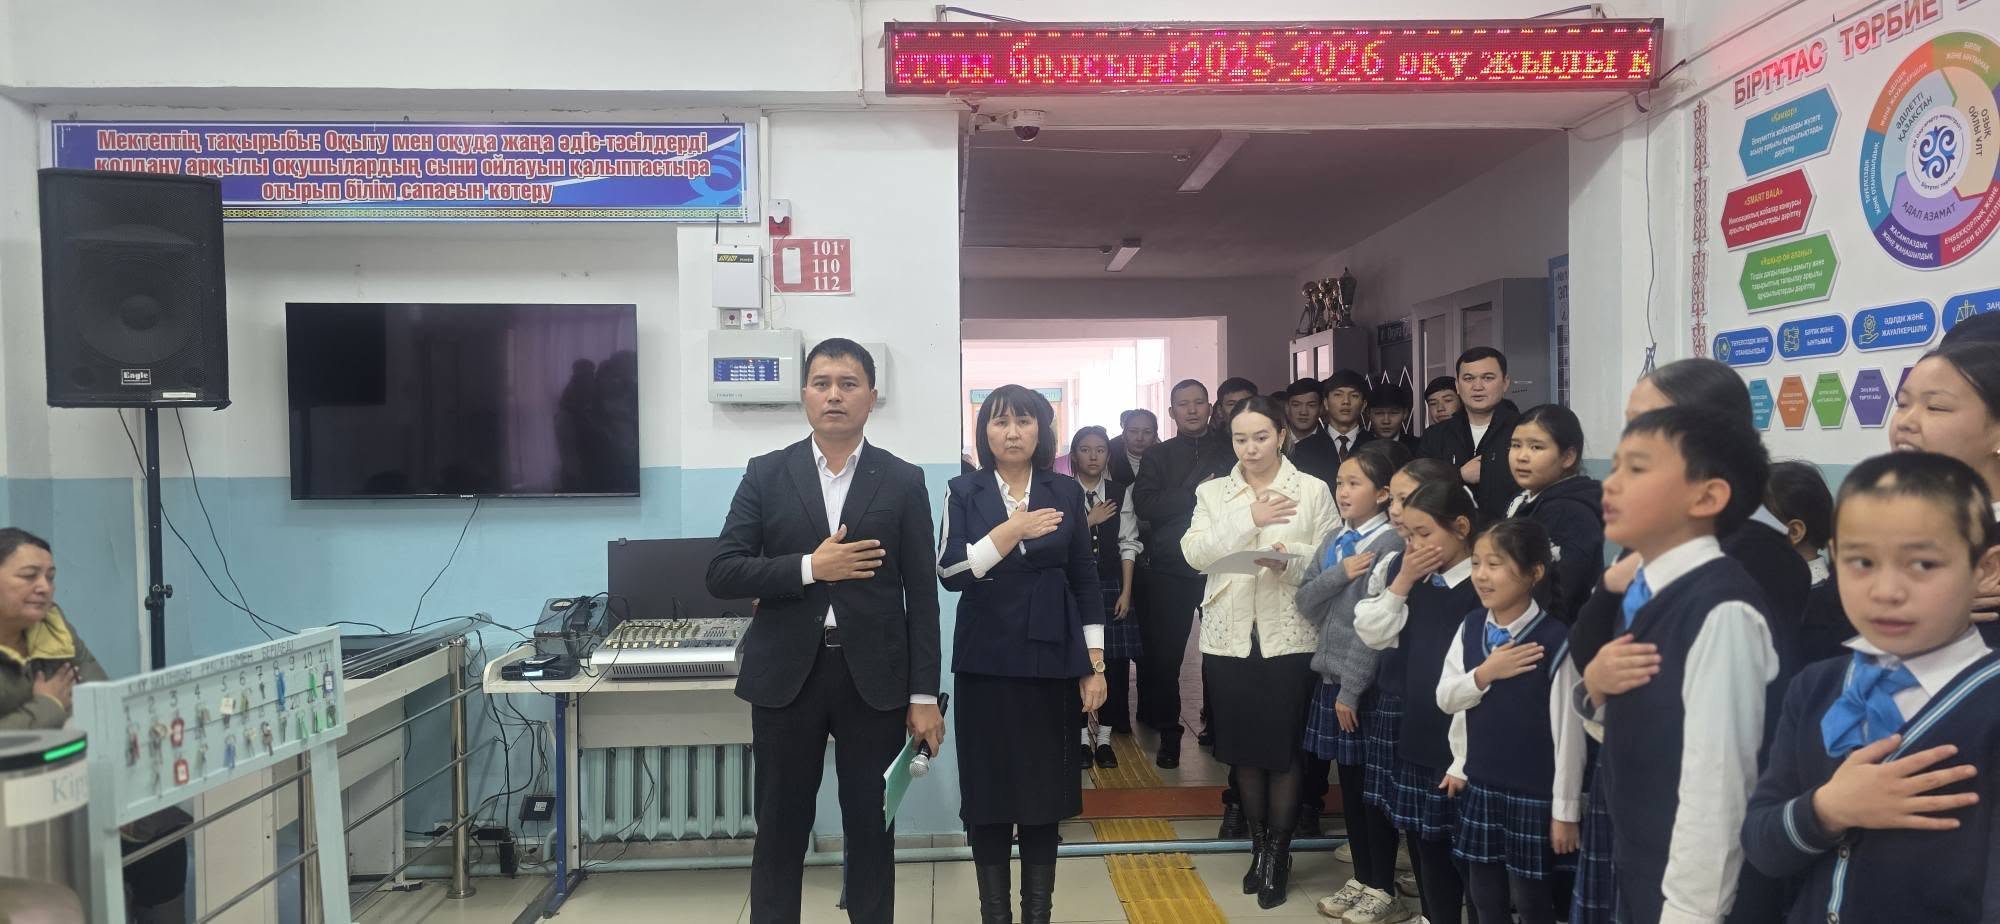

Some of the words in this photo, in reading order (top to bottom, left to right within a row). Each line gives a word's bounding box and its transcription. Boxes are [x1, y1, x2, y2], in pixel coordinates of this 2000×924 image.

[1735, 42, 1822, 104] БІРТҰТАС
[1840, 0, 1937, 56] ТӘРБИЕ
[1896, 92, 1924, 129] ӘДІЛЕТТІ
[97, 130, 203, 156] Мектептің
[206, 130, 320, 155] тақырыбы:
[325, 130, 389, 155] Оқыту
[393, 133, 434, 152] мен
[437, 132, 498, 155] оқуда
[502, 133, 554, 155] жаңа
[559, 132, 708, 155] әдіс-тәсілдерді
[185, 157, 269, 177] арқылы
[274, 157, 421, 179] оқушылардың
[426, 158, 476, 176] сыни
[481, 156, 565, 177] ойлауын
[569, 158, 710, 180] қалыптастыра
[262, 180, 342, 203] отырып
[345, 179, 396, 200] білім
[401, 181, 485, 201] сапасын
[489, 181, 553, 203] көтеру
[1902, 201, 1922, 220] АДАЛ
[1924, 202, 1957, 221] АЗАМАТ
[813, 258, 840, 273] 110
[813, 276, 840, 290] 112
[123, 371, 149, 380] Eagle
